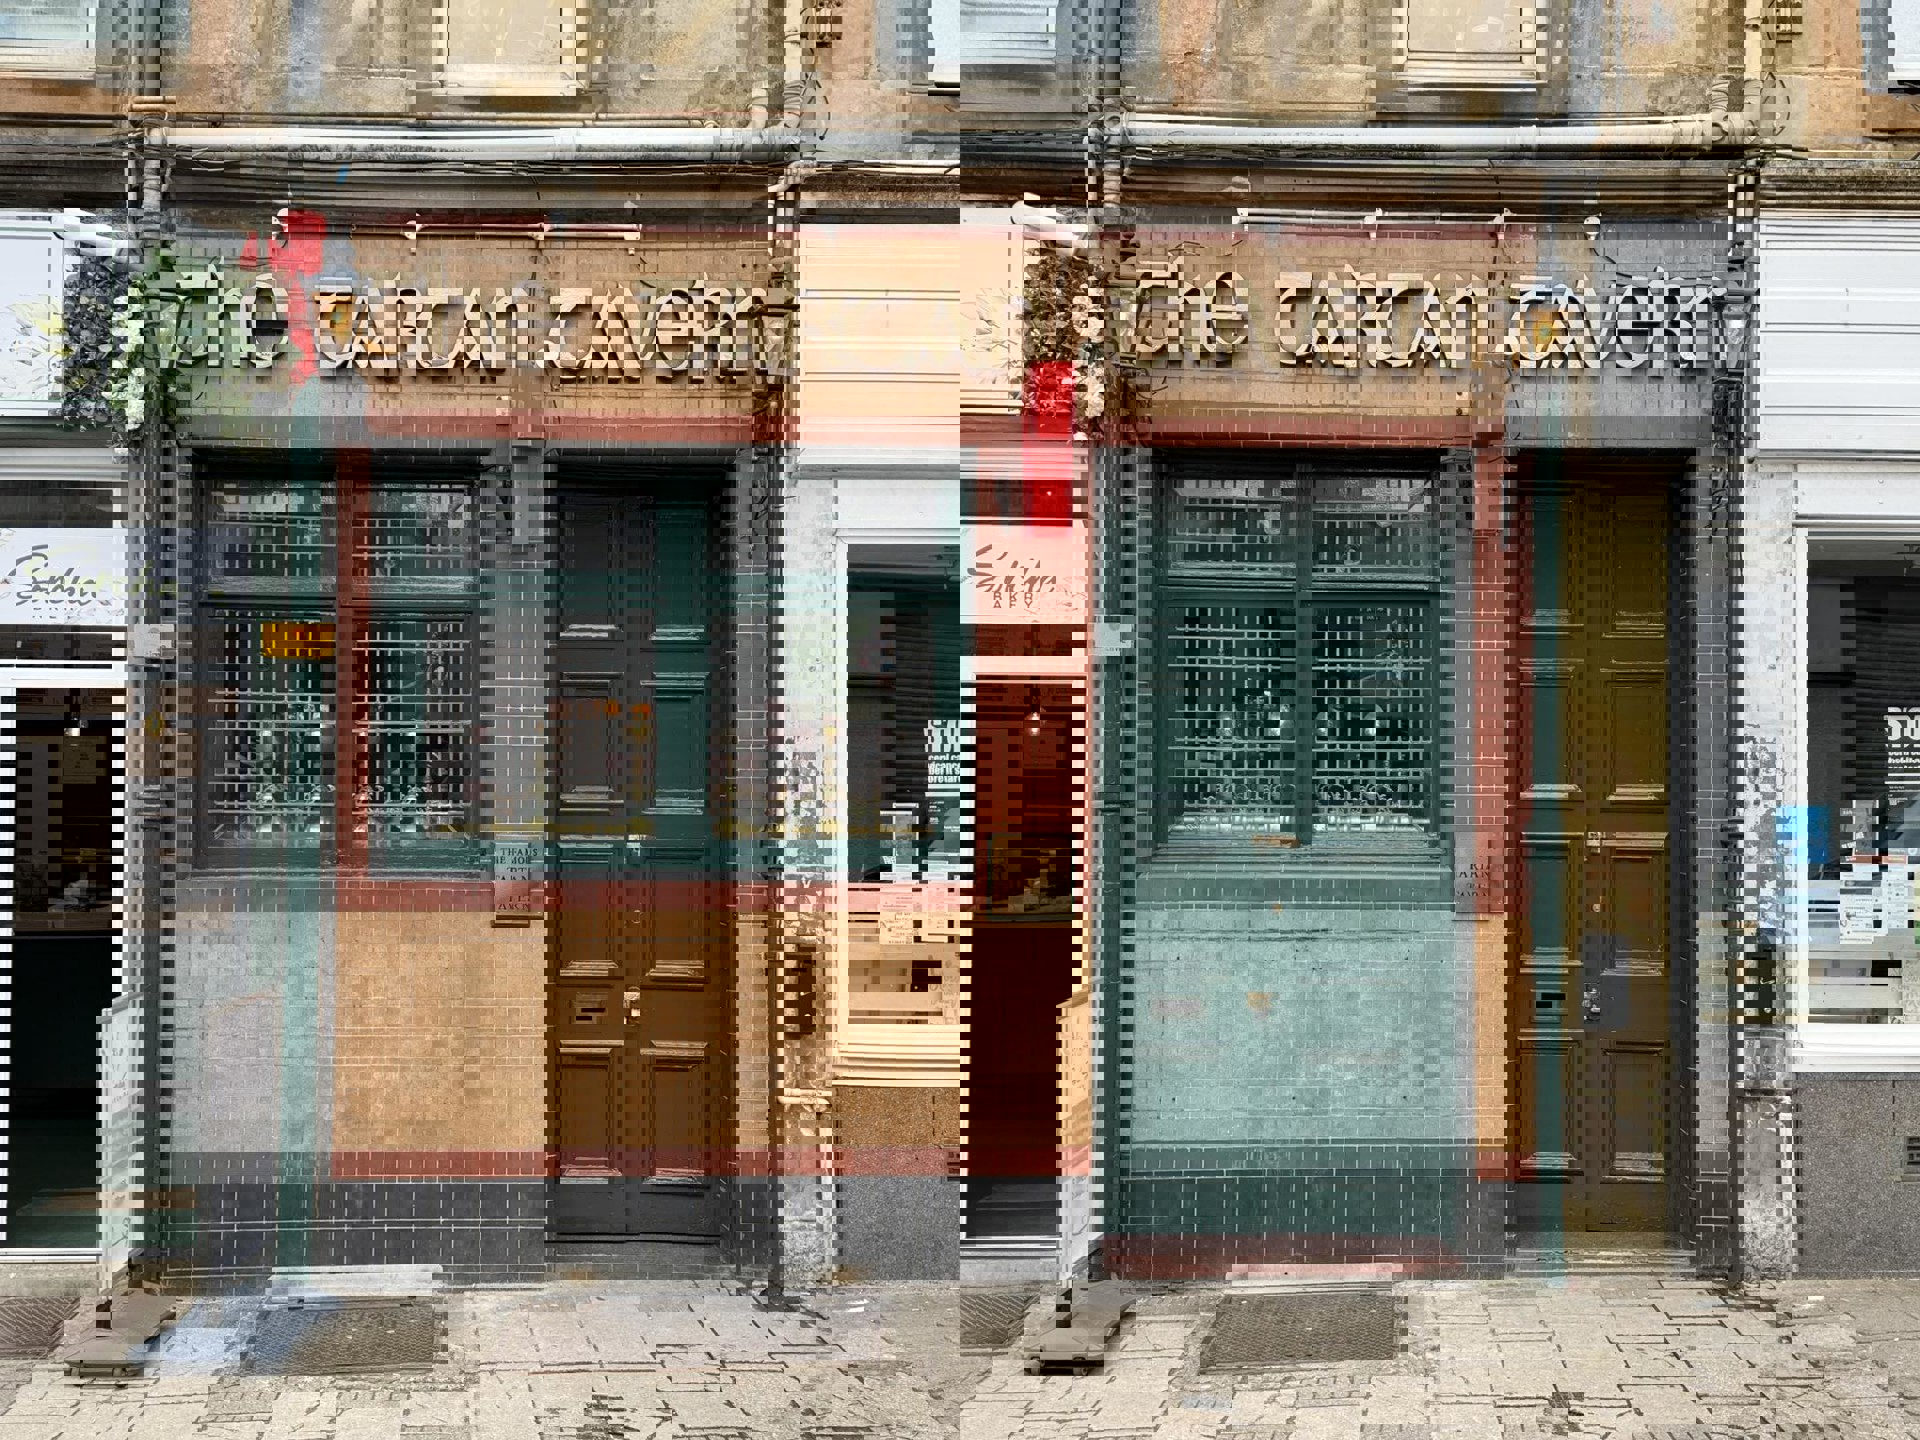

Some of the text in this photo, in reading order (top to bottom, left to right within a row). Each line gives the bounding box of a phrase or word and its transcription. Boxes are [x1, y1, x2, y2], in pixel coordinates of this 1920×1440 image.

[23, 543, 191, 600] Sorcha
[64, 599, 154, 611] BAKERY
[1856, 752, 1893, 764] cervical
[1856, 764, 1888, 776] before
[996, 848, 1066, 857] THE FAMOUS
[1003, 867, 1059, 878] TARTAN
[1002, 891, 1059, 902] TAVERN
